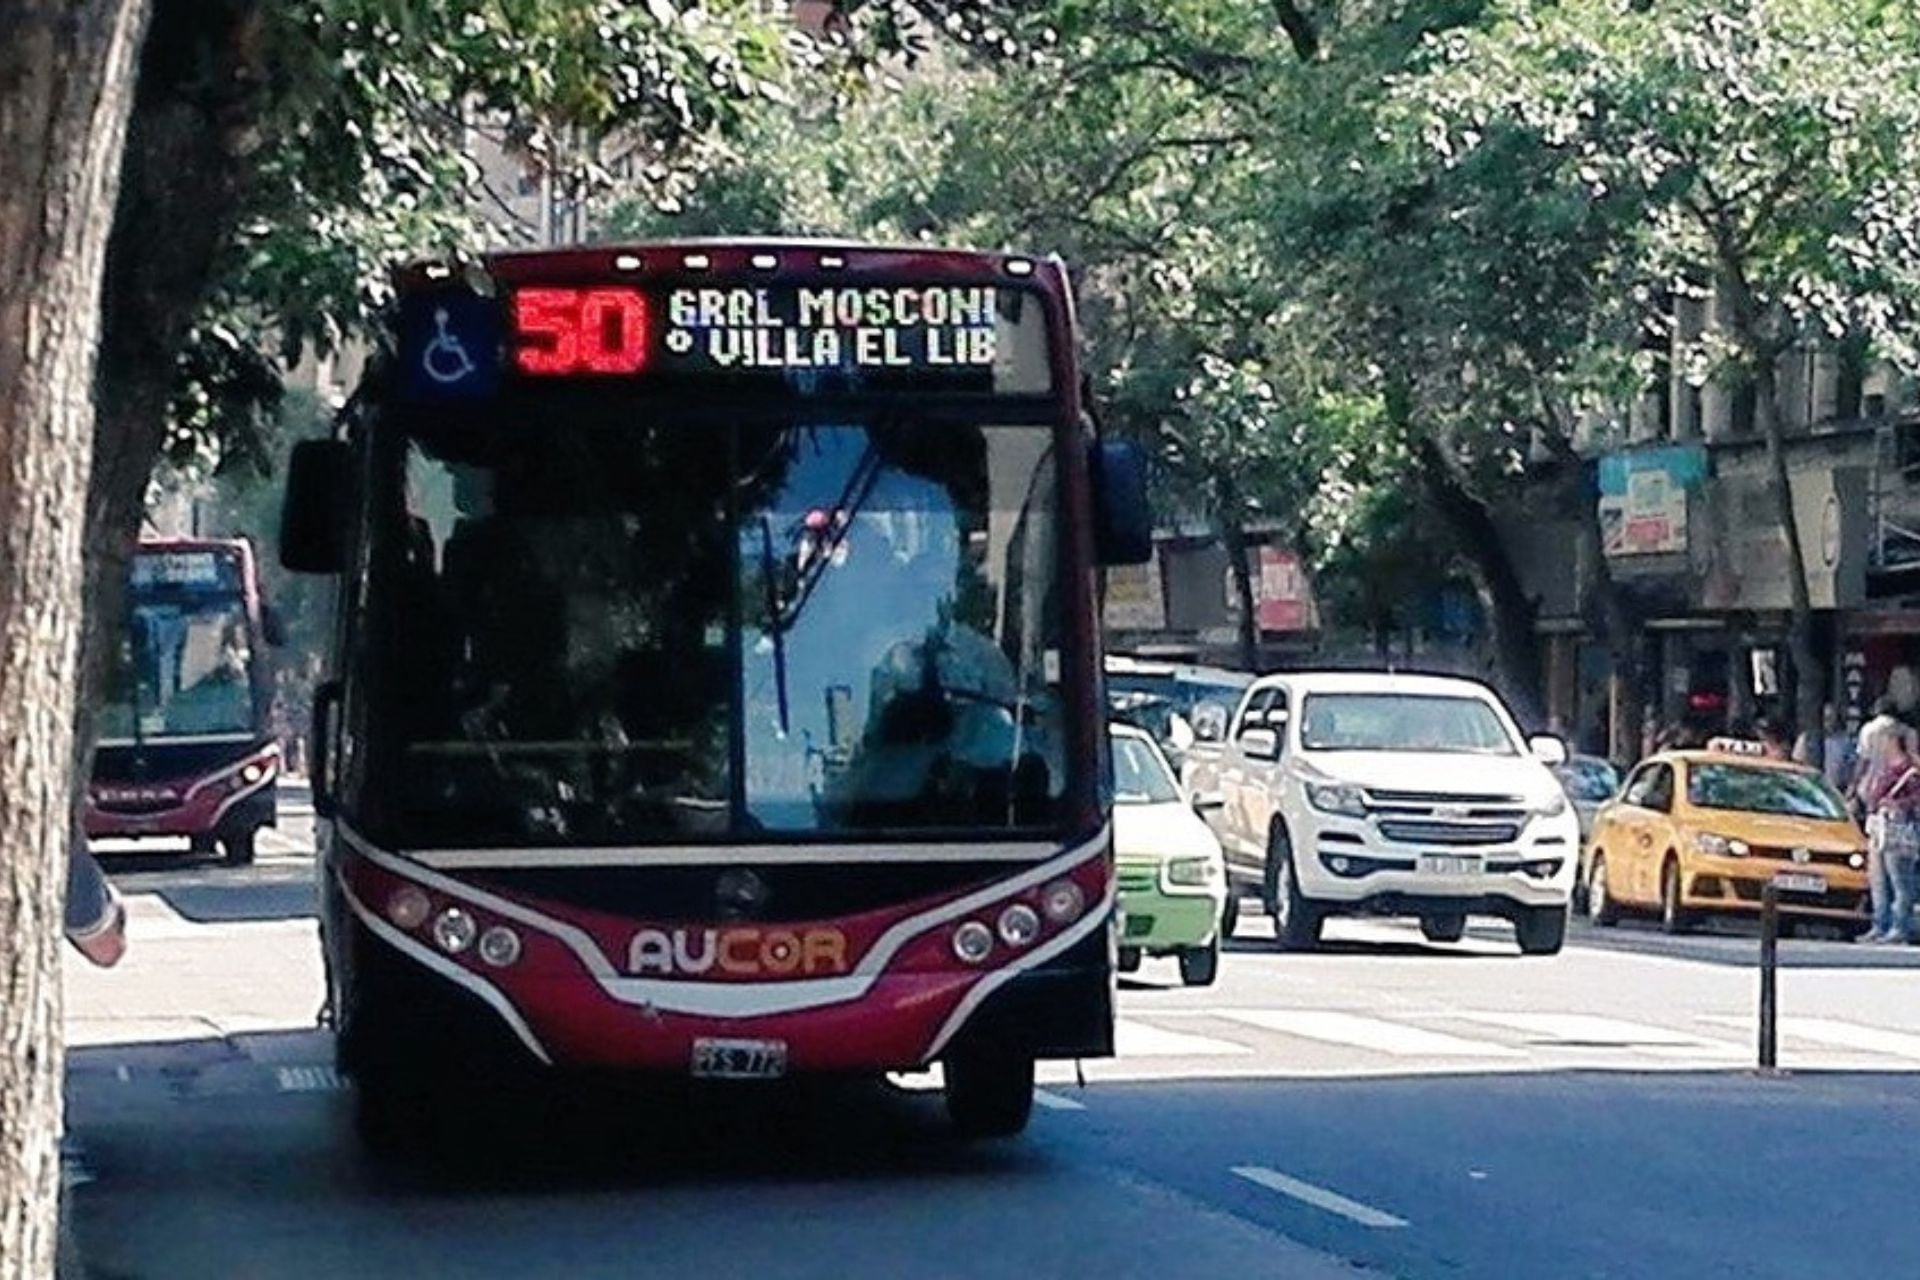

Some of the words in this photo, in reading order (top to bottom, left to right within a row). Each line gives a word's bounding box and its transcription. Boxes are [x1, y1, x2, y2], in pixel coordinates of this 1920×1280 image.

[669, 289, 783, 326] GRAL
[798, 287, 996, 325] MOSCONI
[517, 288, 645, 373] 50
[709, 328, 840, 366] VILLA
[857, 327, 912, 365] EL
[927, 327, 997, 364] LIB
[628, 929, 848, 974] AUCOR
